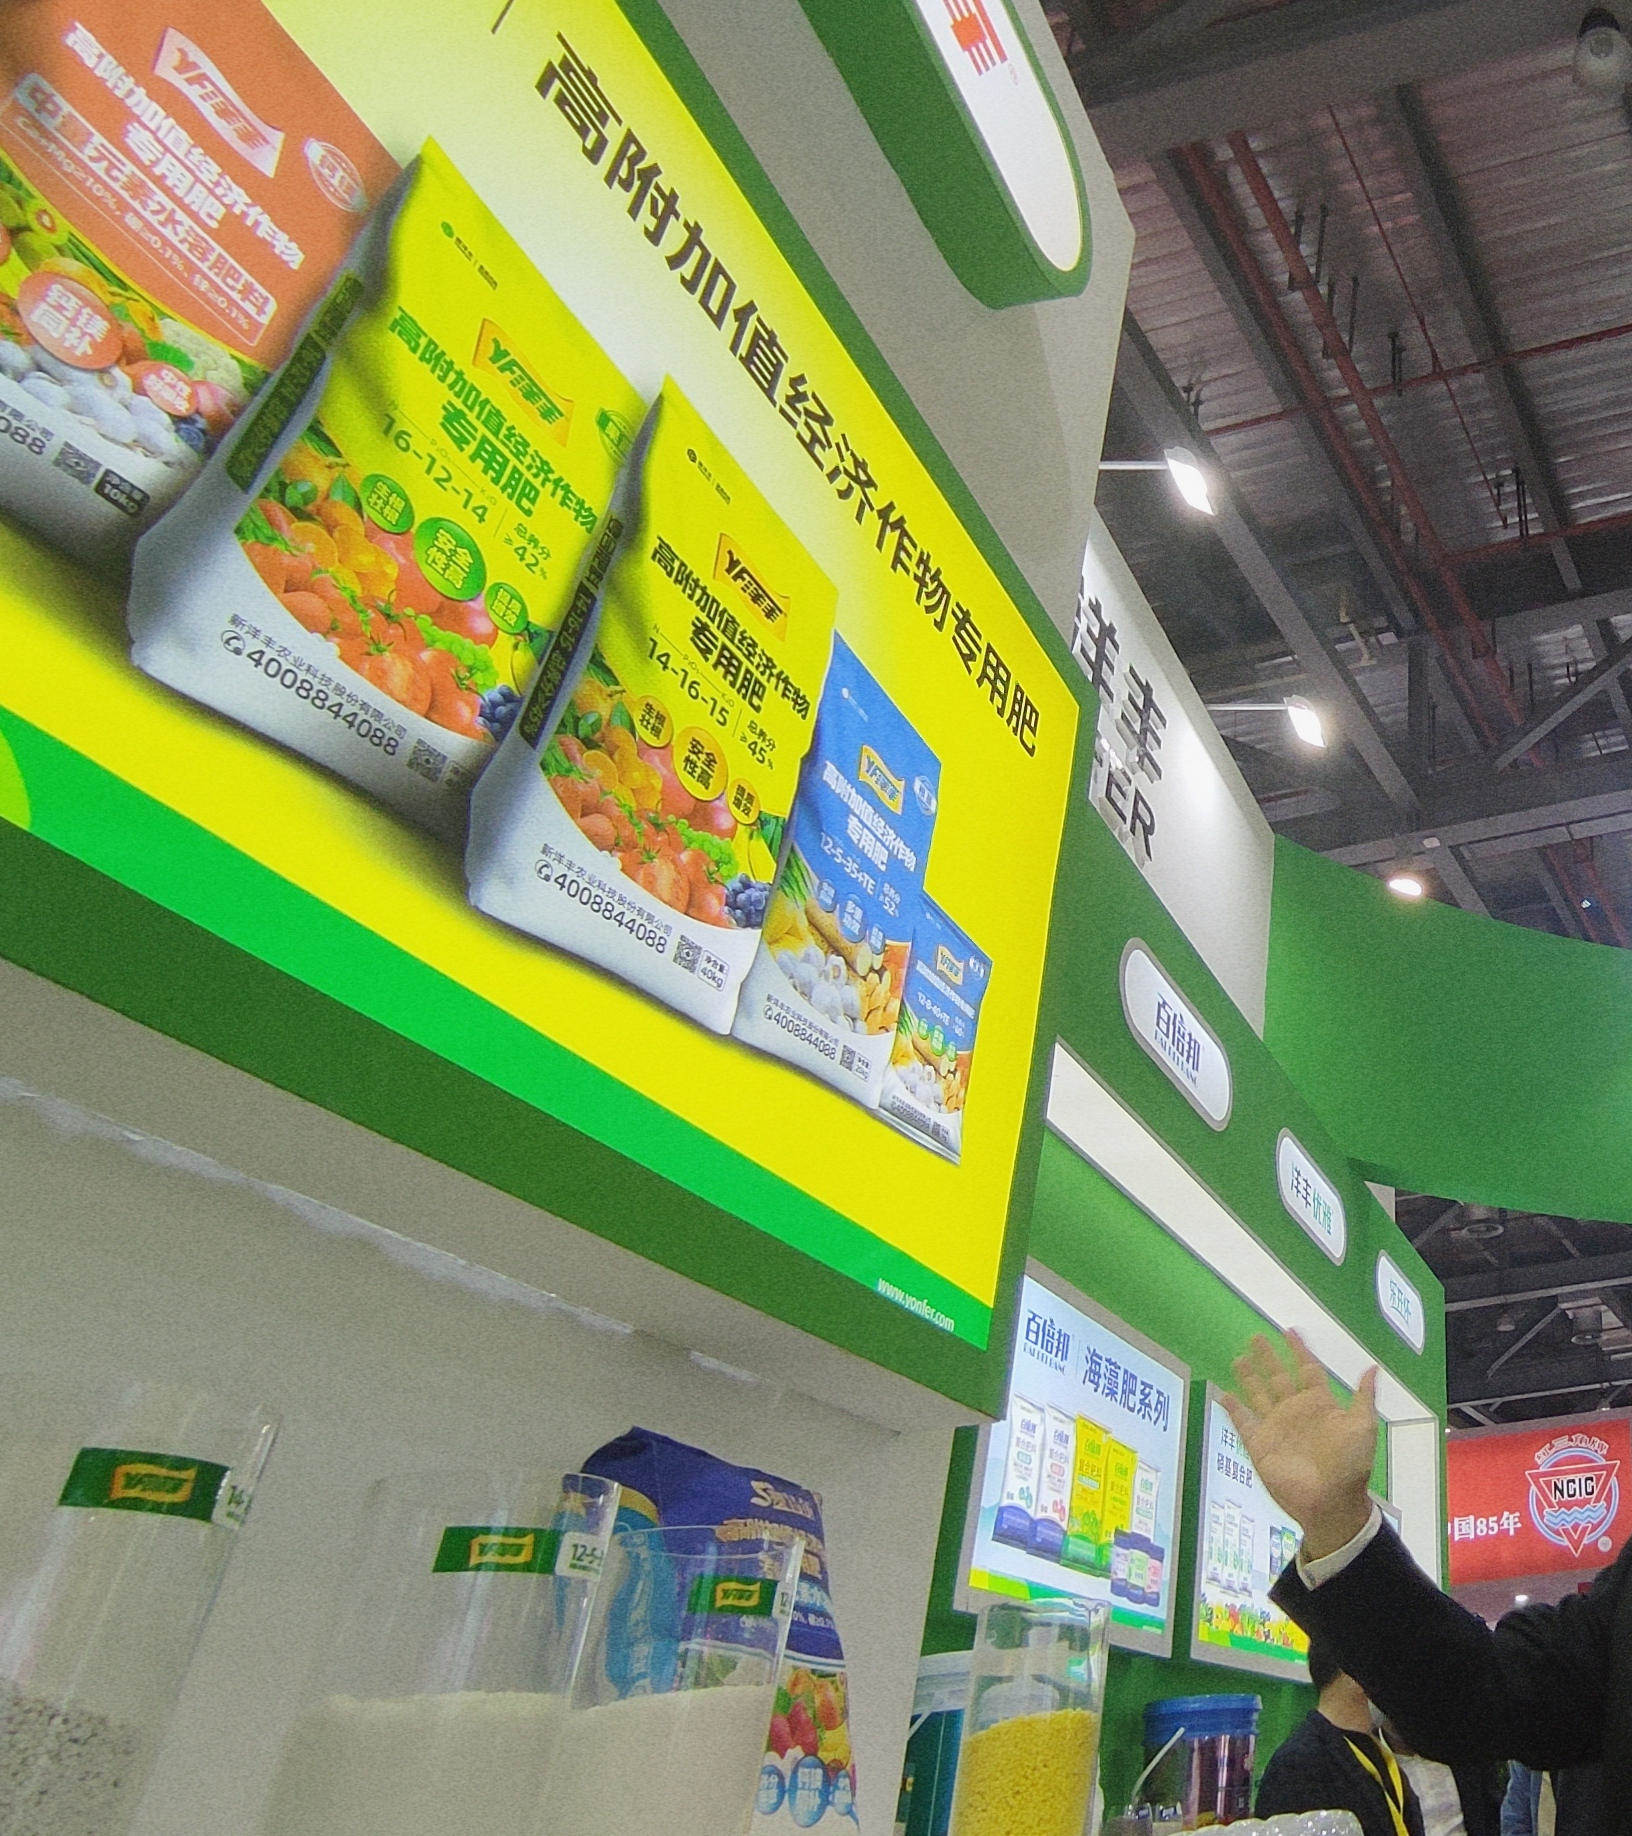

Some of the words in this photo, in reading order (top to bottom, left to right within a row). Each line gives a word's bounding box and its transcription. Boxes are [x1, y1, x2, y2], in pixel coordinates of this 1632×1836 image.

[63, 20, 306, 270] 高附加值经济作物
[123, 120, 227, 230] 专用肥
[388, 306, 599, 534] 高附加值经济作物
[535, 32, 1040, 758] 高附加值经济作物专用肥
[378, 412, 490, 525] 16-12-14
[440, 400, 541, 518] 专用肥
[426, 545, 469, 589] 性高
[433, 528, 475, 572] 安全
[651, 534, 812, 721] 高附加值经济作物
[690, 616, 767, 714] 专用肥
[246, 648, 401, 757] 4008844088
[649, 637, 730, 728] 14-16-15
[683, 755, 715, 791] 性高
[689, 736, 719, 775] 安全
[847, 813, 889, 873] 专用肥
[553, 872, 669, 954] 4008844088
[700, 964, 724, 989] 40kg
[773, 1011, 837, 1061] 4008844088
[877, 1277, 956, 1333] www.yonfer.com
[1024, 1308, 1071, 1363] 百倍邦
[1082, 1344, 1171, 1433] 海藻肥系列
[1446, 1510, 1522, 1543] 国85年
[1553, 1475, 1595, 1501] NCIC
